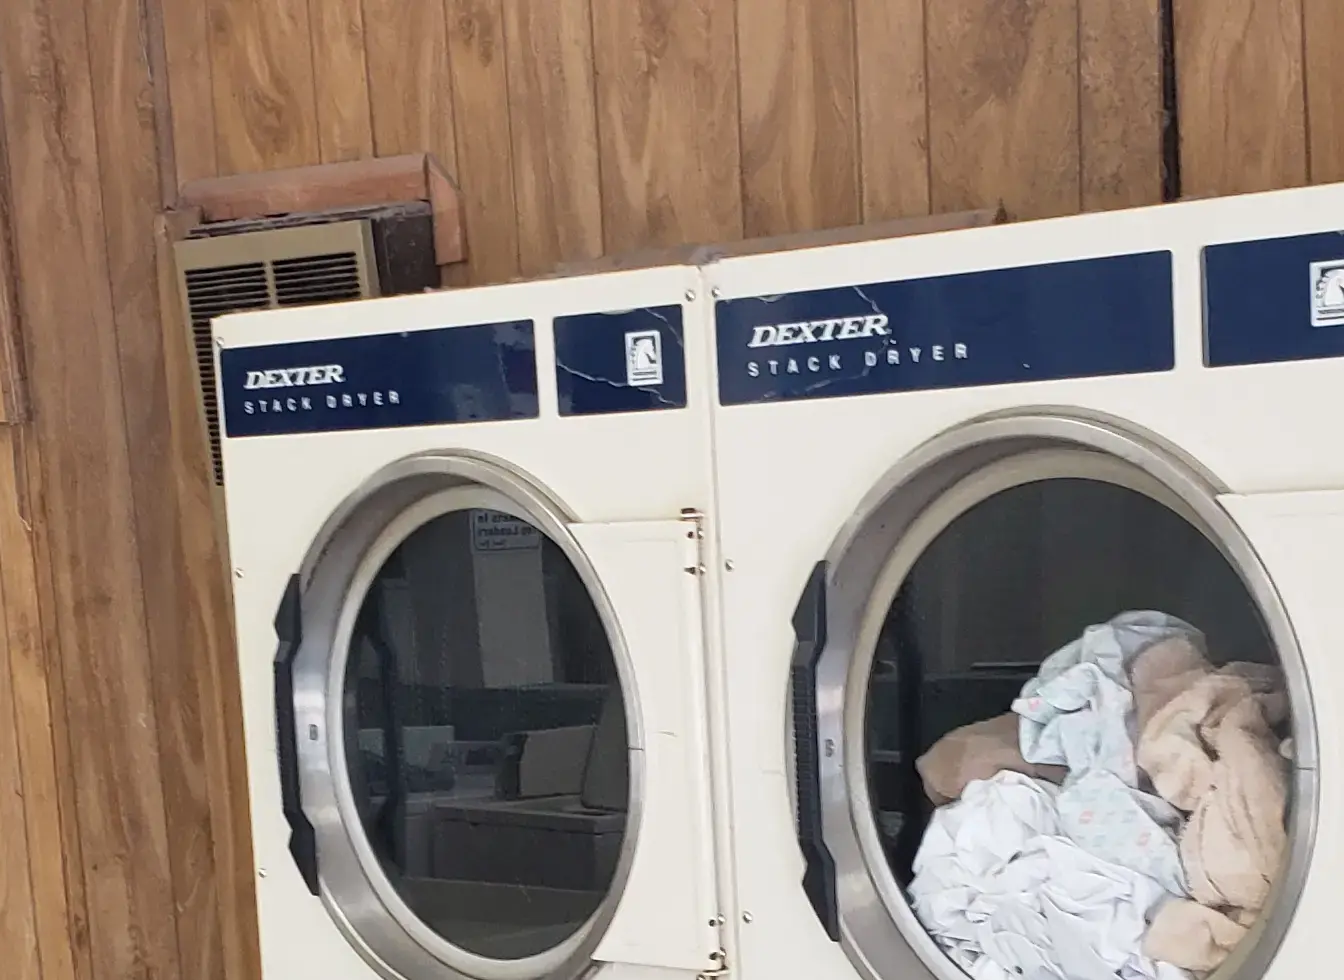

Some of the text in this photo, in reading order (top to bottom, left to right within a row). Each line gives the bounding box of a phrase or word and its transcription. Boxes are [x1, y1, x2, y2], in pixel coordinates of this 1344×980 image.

[747, 313, 889, 348] DEXTER
[747, 343, 968, 378] STACK DRYER
[243, 364, 344, 390] DEXTER
[244, 390, 400, 415] STACK DRYER
